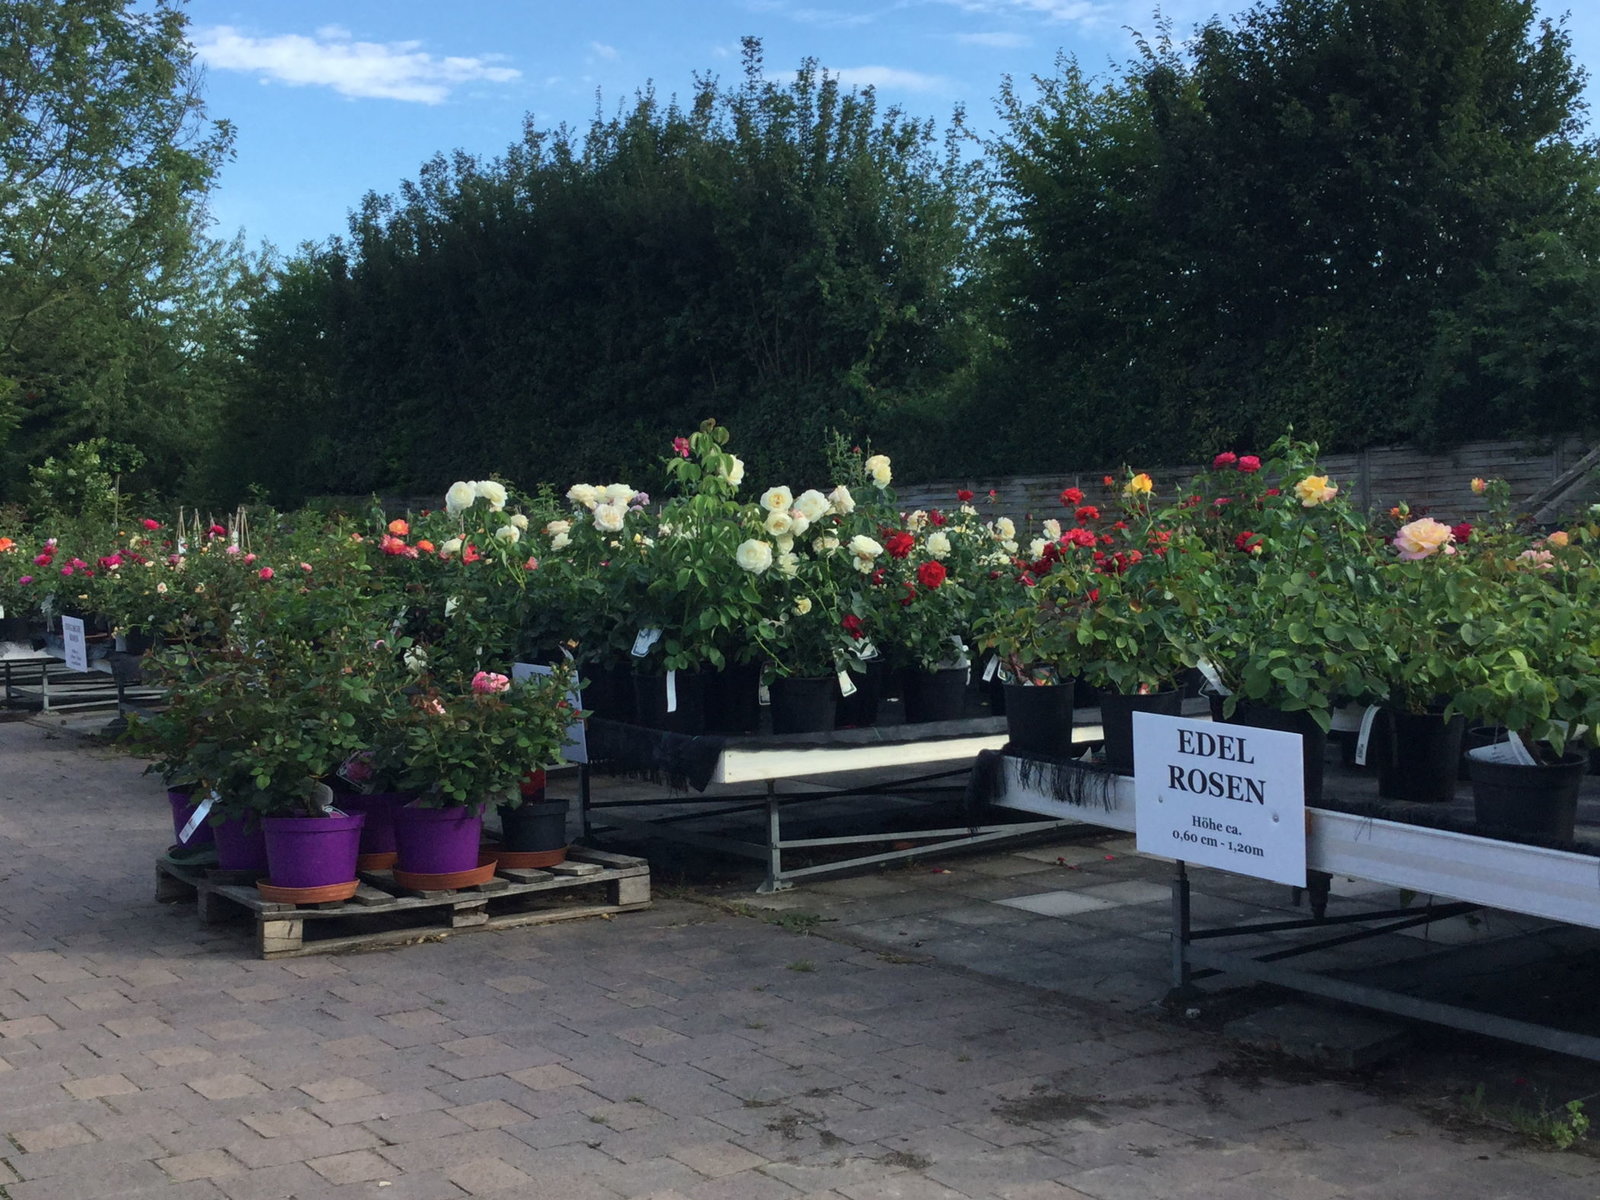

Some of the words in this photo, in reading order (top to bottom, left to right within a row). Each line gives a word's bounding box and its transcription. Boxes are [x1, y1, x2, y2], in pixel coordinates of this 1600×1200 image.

[1177, 728, 1254, 765] EDEL
[1167, 764, 1266, 806] ROSEN
[1192, 815, 1223, 832] Höhe
[1225, 824, 1242, 836] ca.
[1172, 829, 1198, 844] 0,60
[1200, 835, 1218, 848] cm
[1228, 841, 1264, 857] 1,20m
